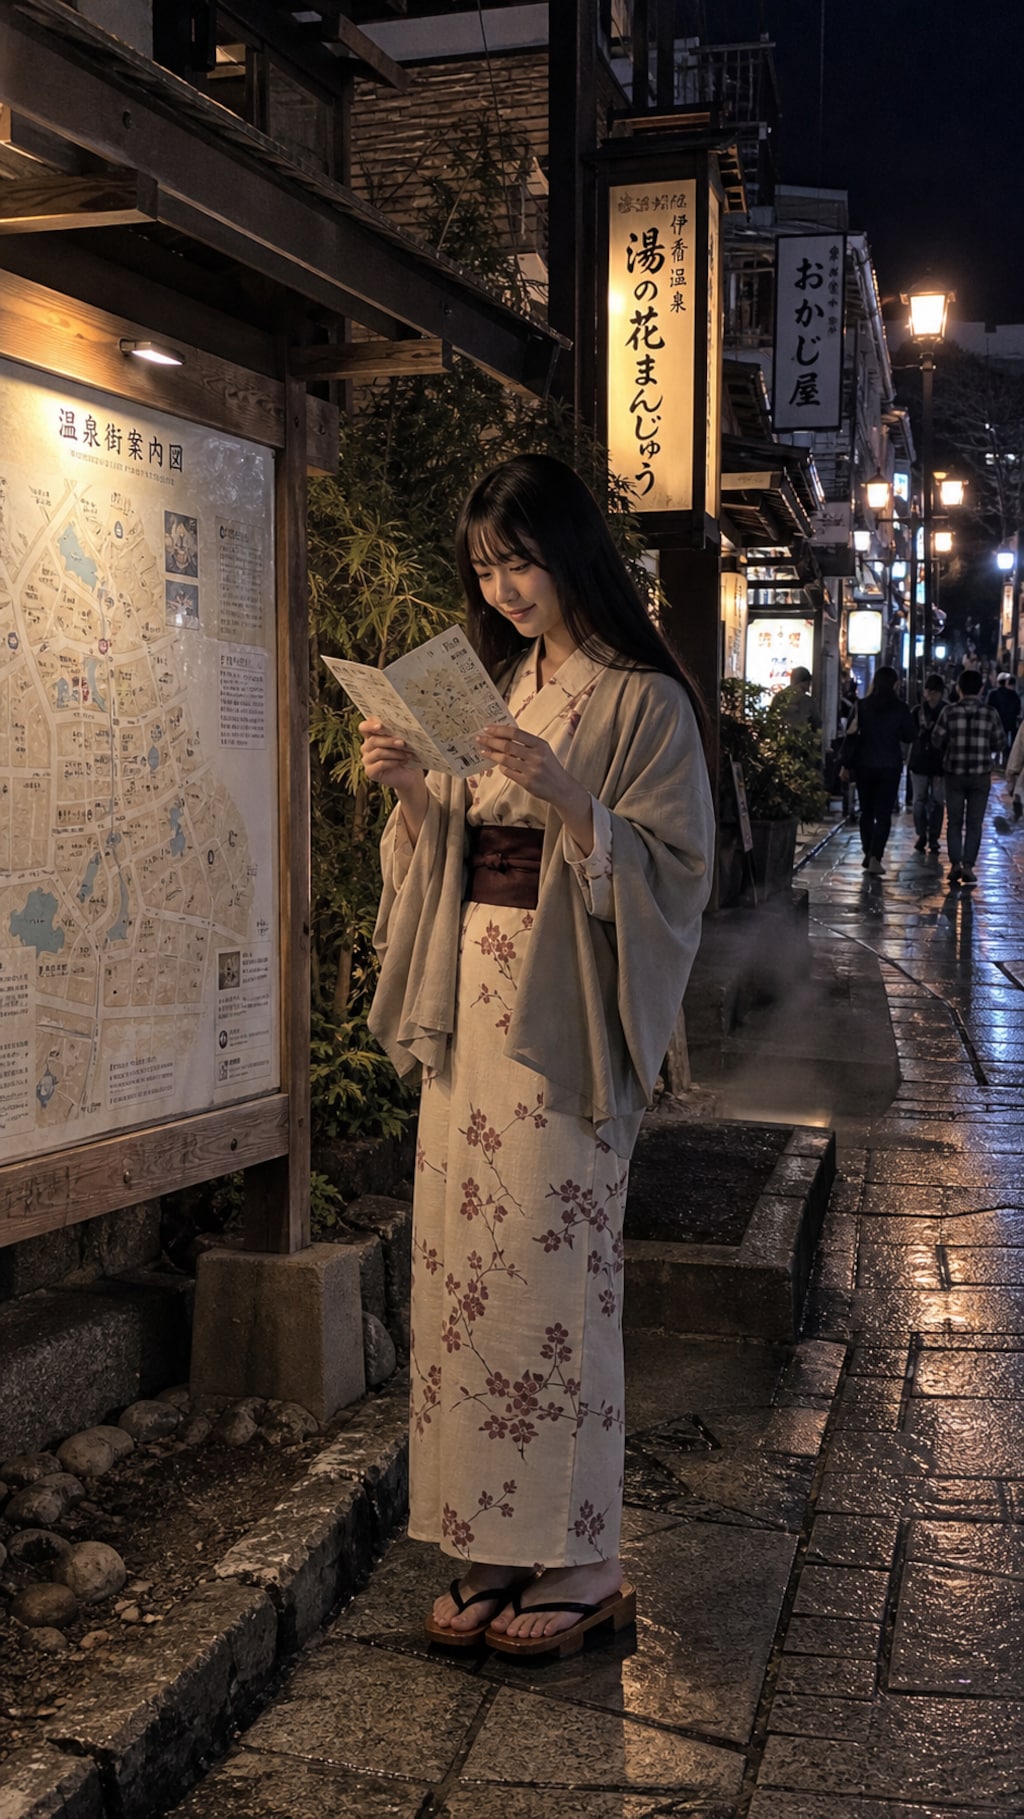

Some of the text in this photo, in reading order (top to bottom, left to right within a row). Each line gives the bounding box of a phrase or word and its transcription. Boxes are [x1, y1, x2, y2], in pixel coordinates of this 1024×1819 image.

[625, 227, 666, 498] 湯の花まんじゅう
[789, 257, 824, 408] おかじ屋
[59, 408, 183, 472] 温泉街案内図
